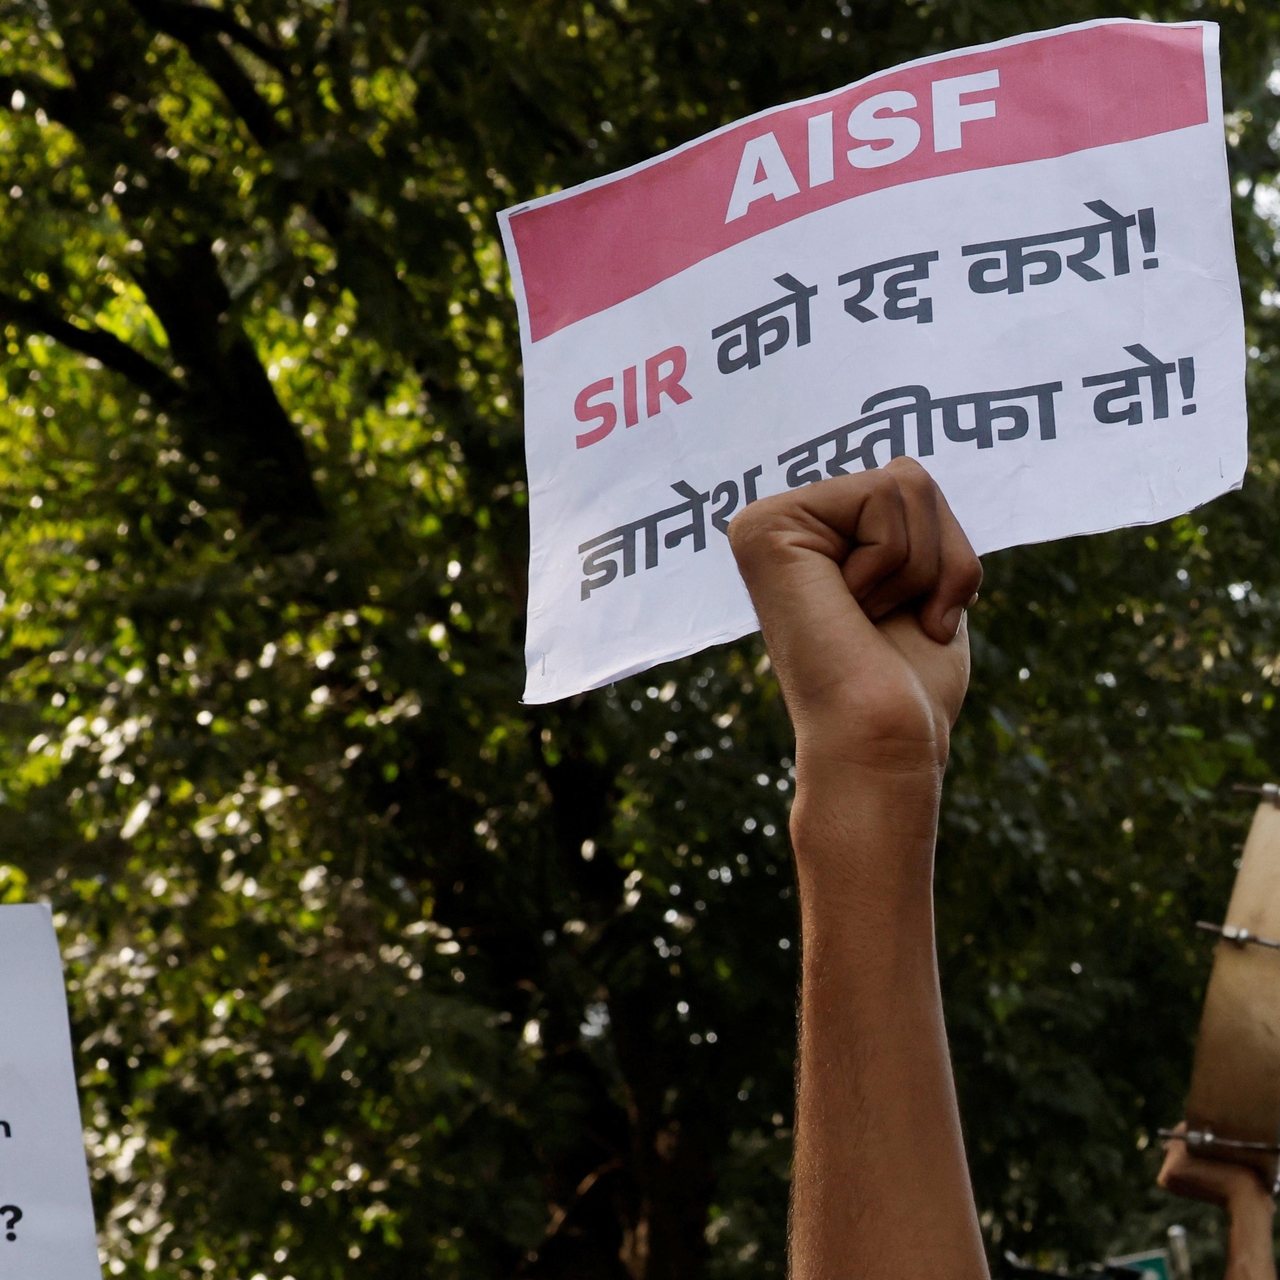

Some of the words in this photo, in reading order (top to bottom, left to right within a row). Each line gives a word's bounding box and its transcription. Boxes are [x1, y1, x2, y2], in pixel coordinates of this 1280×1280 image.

[724, 69, 1000, 224] AISF
[573, 345, 693, 450] SIR
[711, 274, 818, 375] को
[839, 251, 938, 324] रद्द
[962, 199, 1159, 295] करो!
[1083, 344, 1196, 425] दो!
